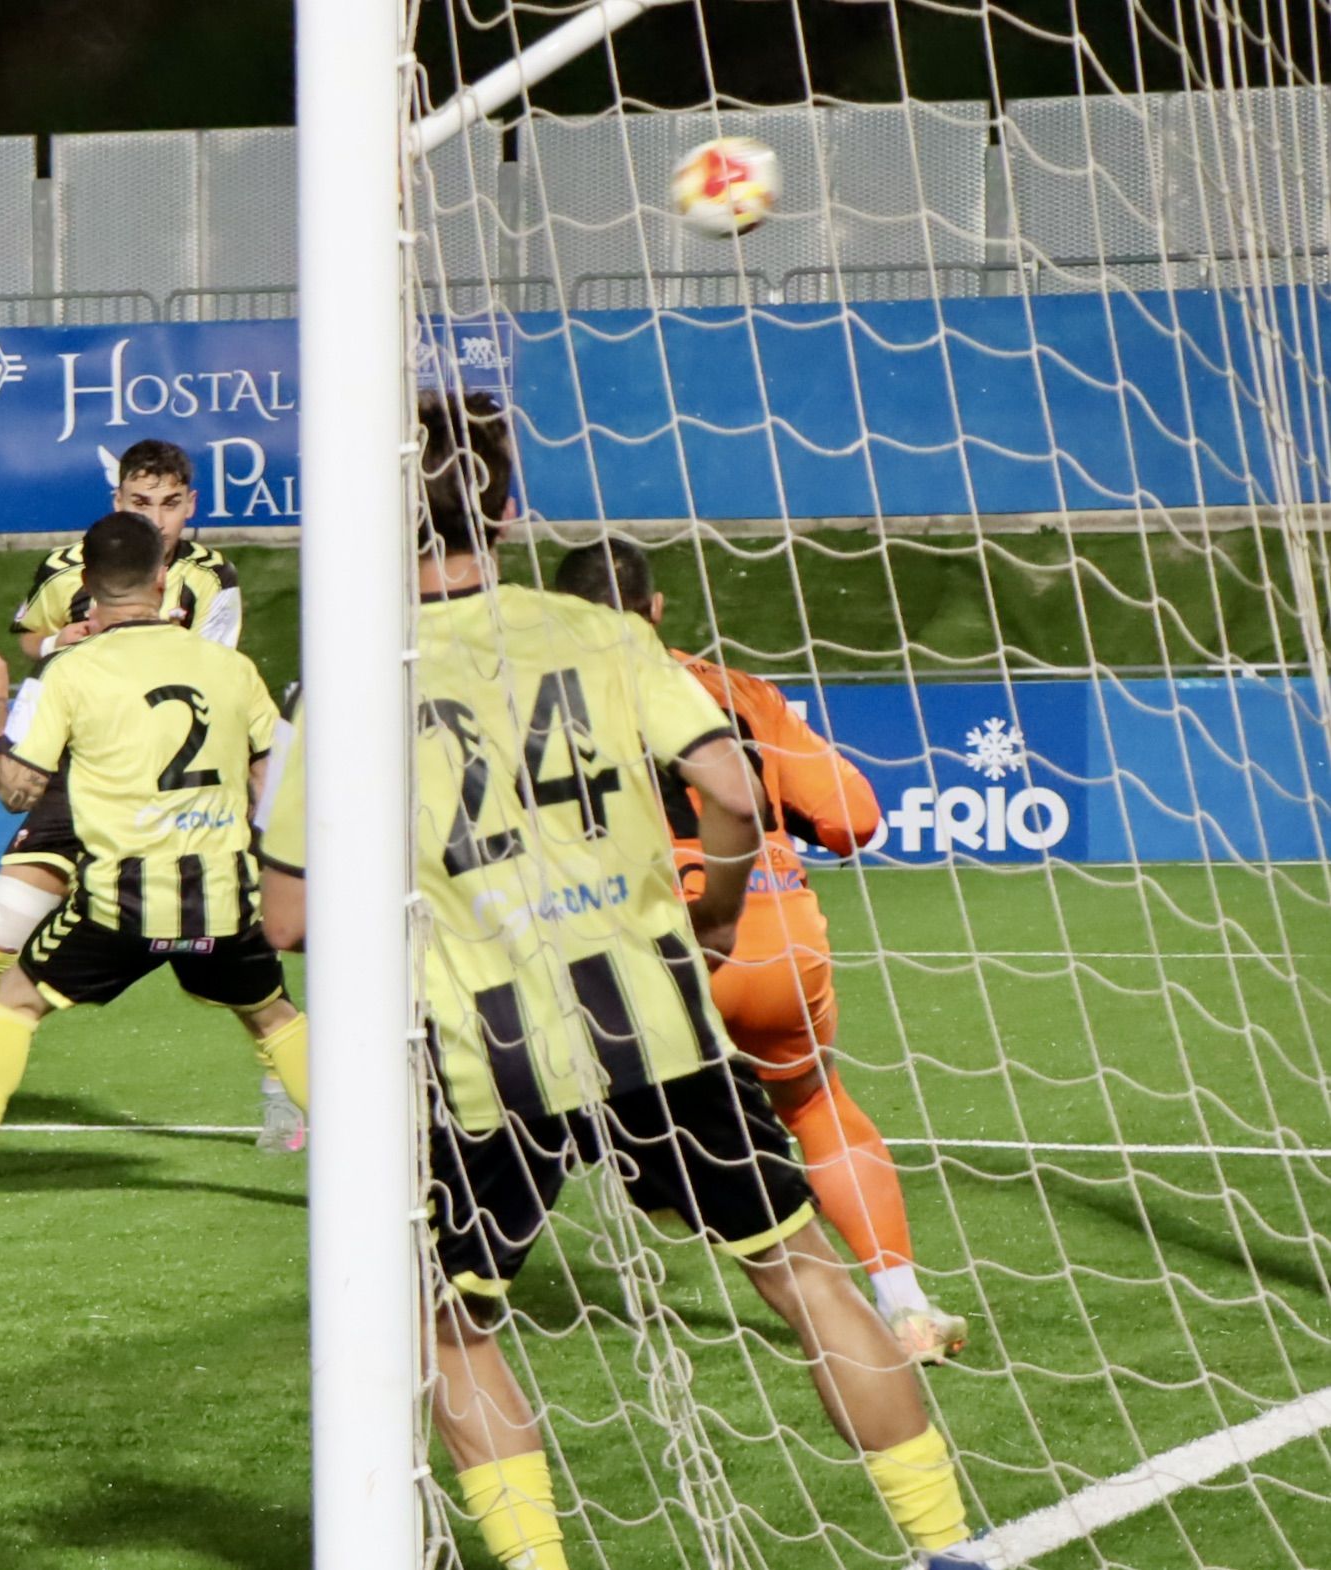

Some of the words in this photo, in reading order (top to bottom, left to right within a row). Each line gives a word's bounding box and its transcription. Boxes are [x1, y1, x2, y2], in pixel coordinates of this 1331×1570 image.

[56, 338, 296, 443] HOSTAL
[144, 684, 223, 793] 2
[418, 667, 623, 878] 24
